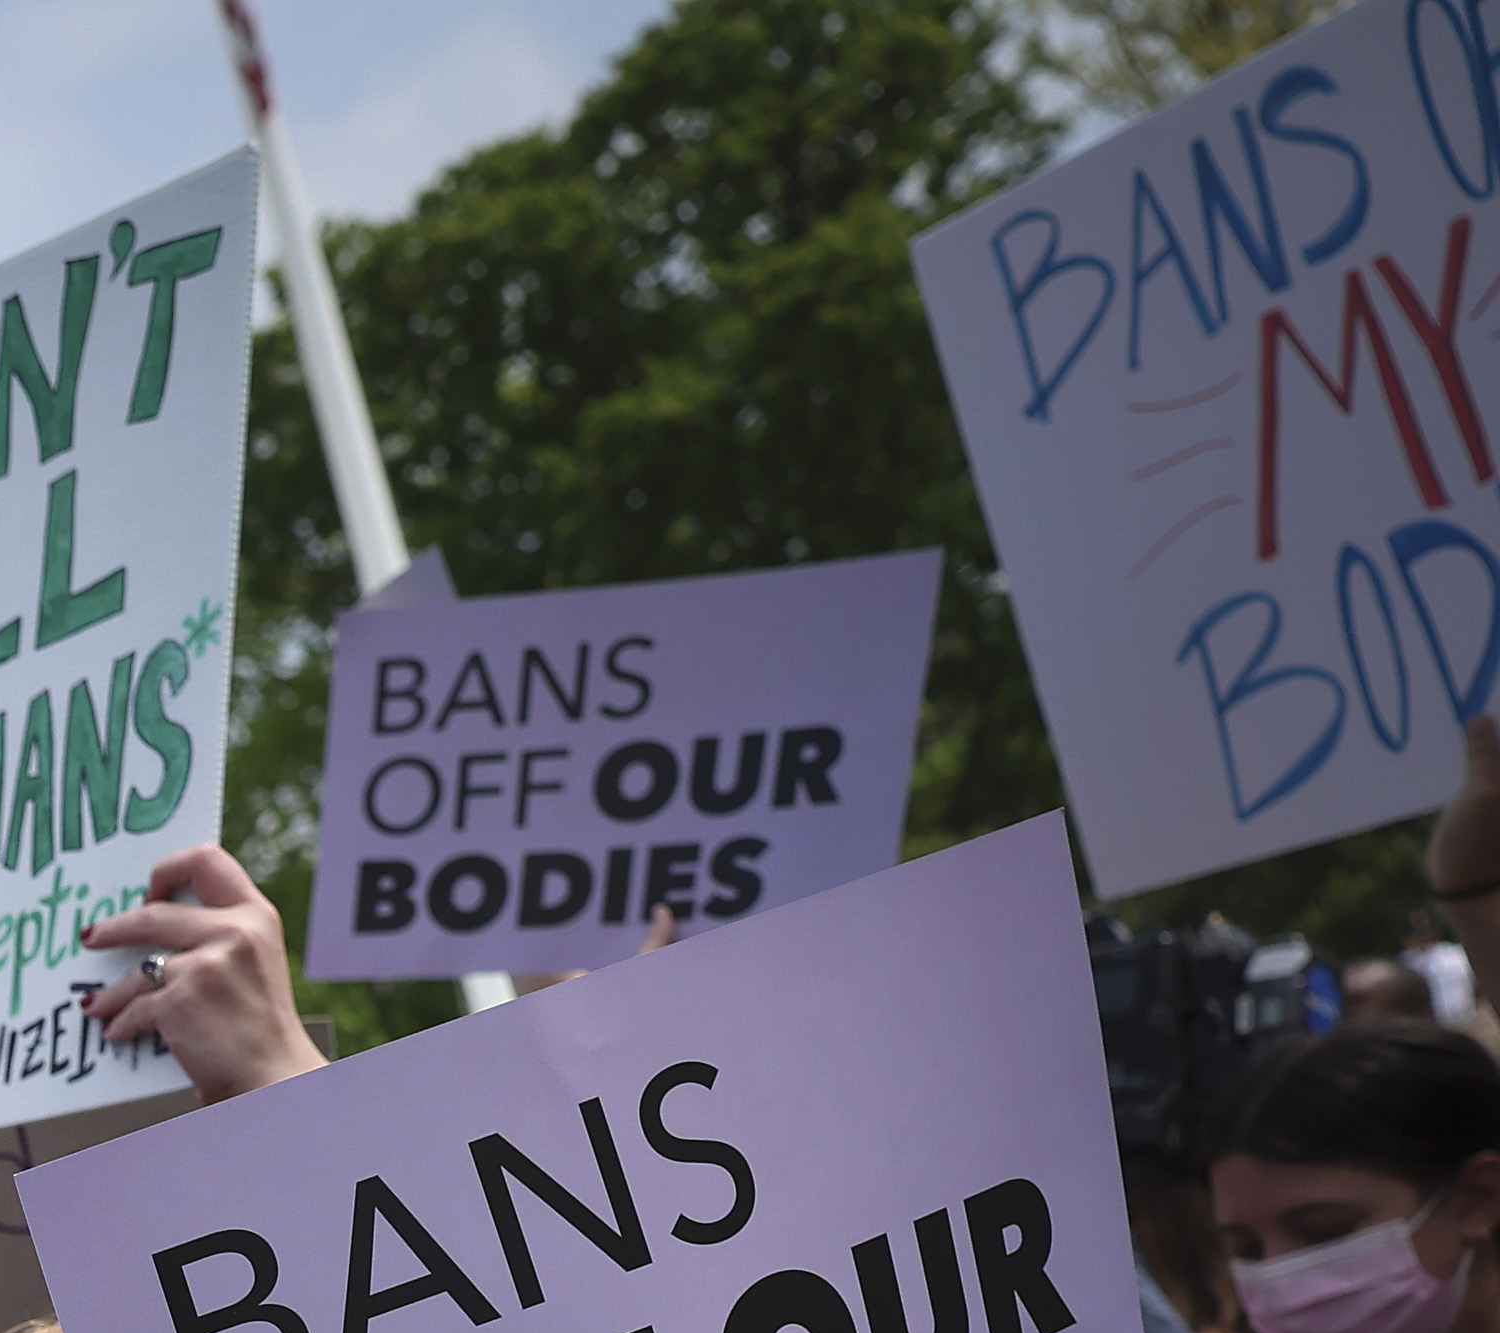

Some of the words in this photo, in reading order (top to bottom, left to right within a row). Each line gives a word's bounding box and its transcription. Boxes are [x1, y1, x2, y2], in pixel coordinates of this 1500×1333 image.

[991, 65, 1372, 423] BANS
[1258, 215, 1498, 560] MY
[370, 634, 656, 736] BANS
[1177, 516, 1500, 823] BOD
[353, 835, 770, 935] BODIES
[361, 747, 569, 838] OFF
[593, 725, 844, 823] OUR
